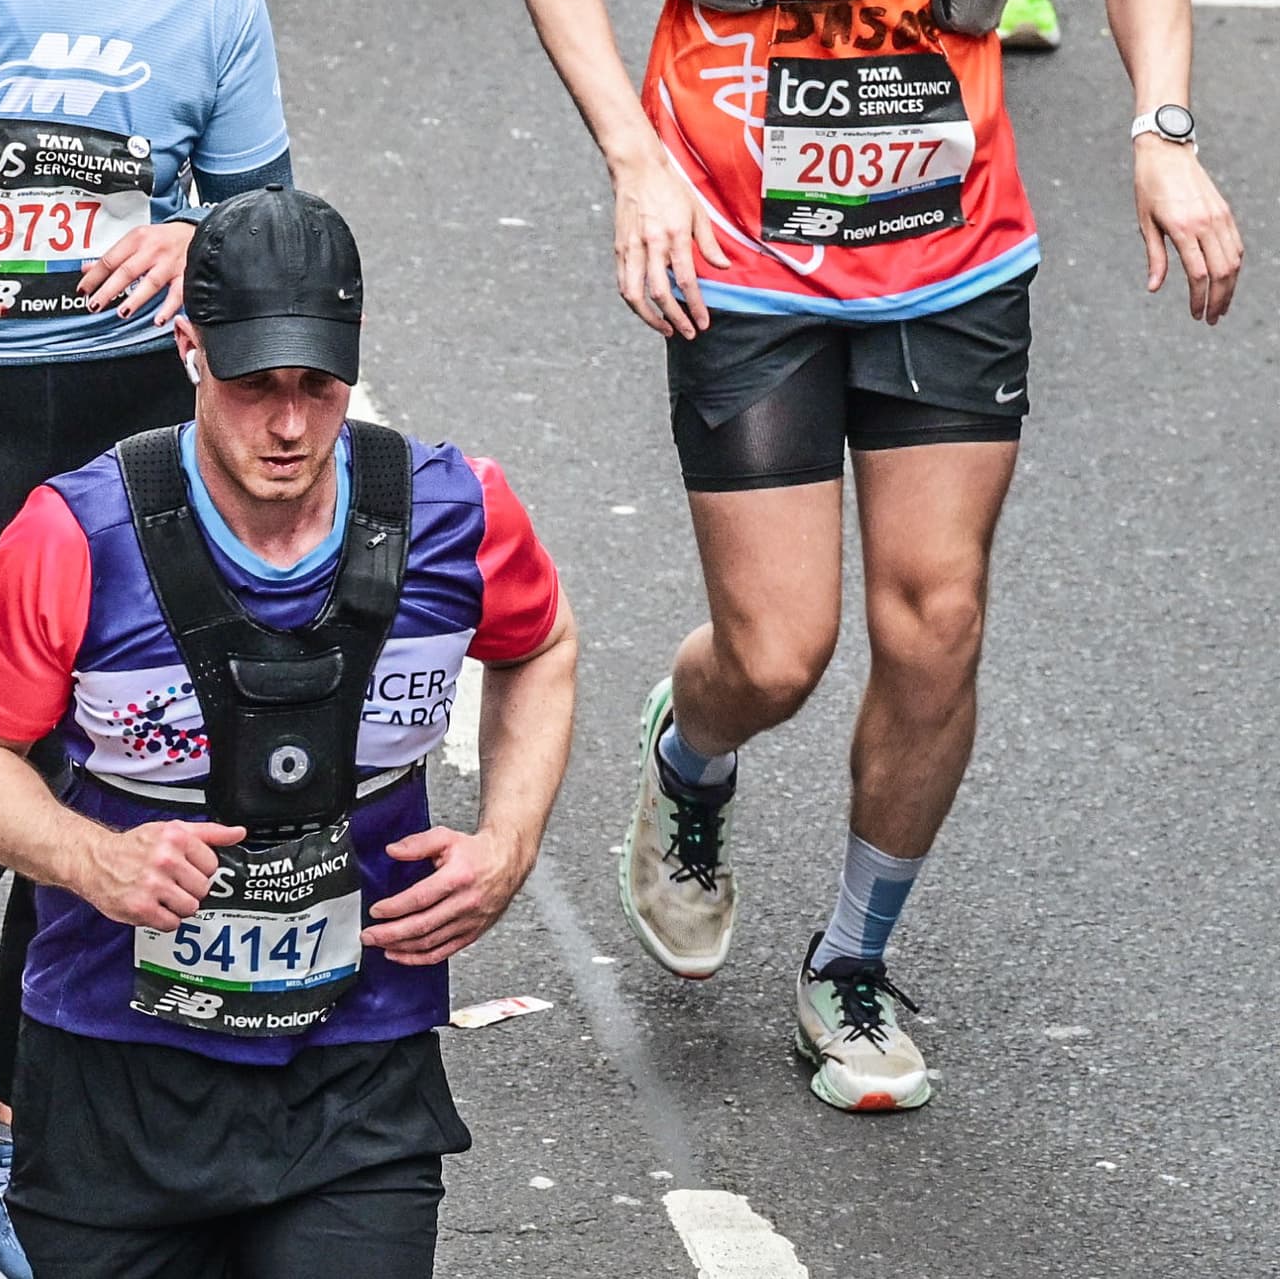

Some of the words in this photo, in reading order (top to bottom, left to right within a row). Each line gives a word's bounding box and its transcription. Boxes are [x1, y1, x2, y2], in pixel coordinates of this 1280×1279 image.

[857, 66, 902, 82] TATA
[779, 68, 850, 116] tcs
[857, 80, 952, 99] CONSULTANCY
[858, 99, 924, 116] SERVICES
[36, 133, 84, 152] TATA
[34, 163, 103, 186] SERVICES
[35, 150, 142, 177] CONSULTANCY
[797, 140, 944, 188] 20377
[843, 225, 877, 241] new
[878, 207, 945, 236] balance
[20, 297, 58, 312] new
[244, 852, 349, 889] CONSULTANCY
[247, 857, 294, 878] TATA
[243, 882, 315, 904] SERVICES
[172, 917, 328, 972] 54147
[223, 1014, 263, 1029] new
